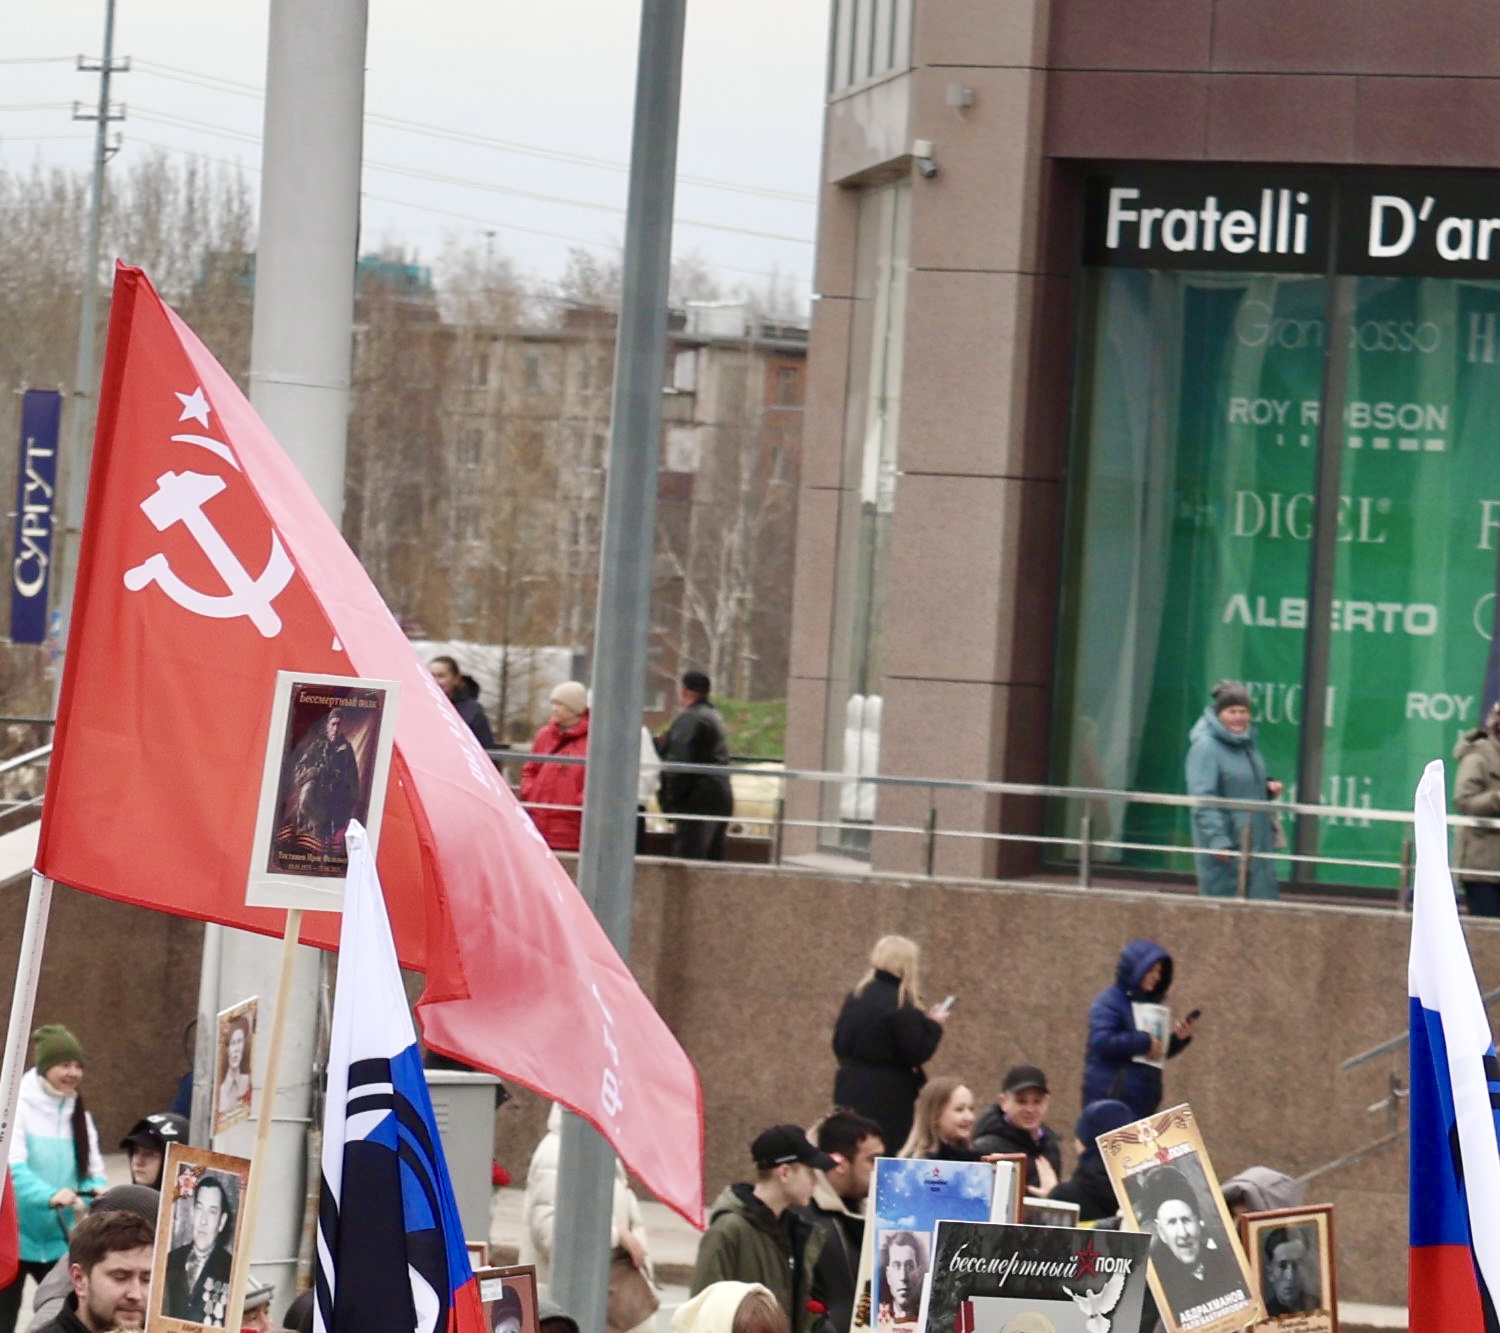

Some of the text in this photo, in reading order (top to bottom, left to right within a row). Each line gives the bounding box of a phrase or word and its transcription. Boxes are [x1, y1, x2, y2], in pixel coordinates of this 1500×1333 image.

[1105, 187, 1308, 254] Fratelli
[1228, 399, 1447, 431] ROY RBSON
[949, 1243, 1133, 1287] бессмертный ПОЛК
